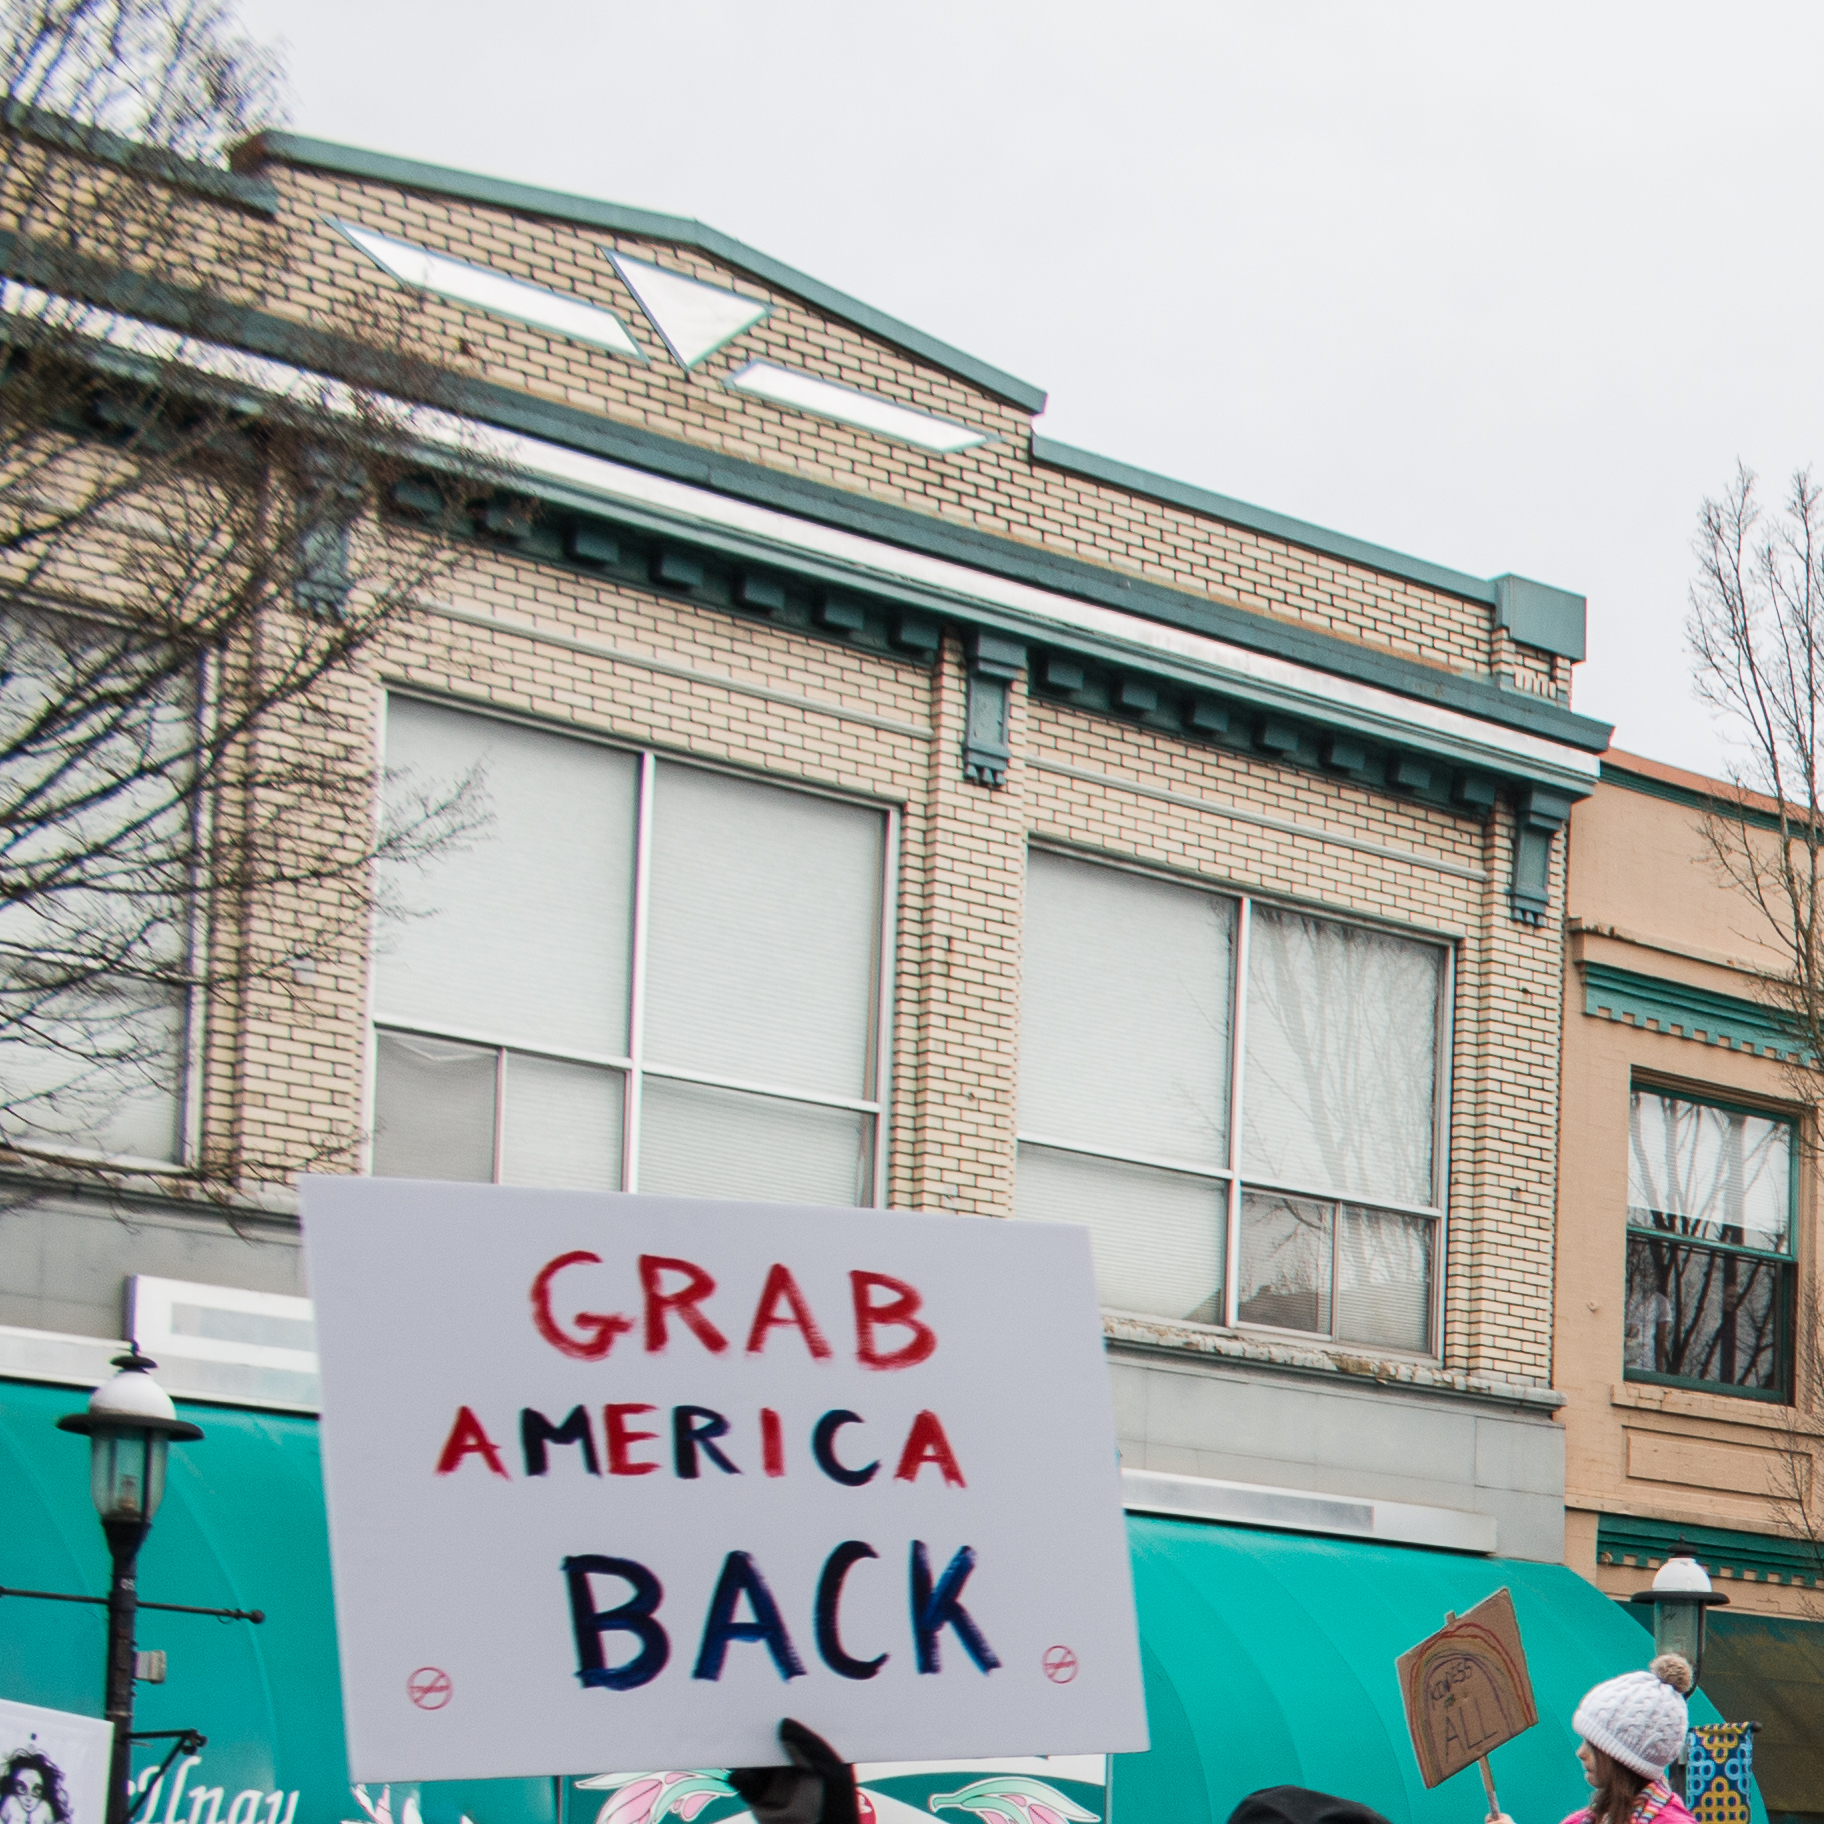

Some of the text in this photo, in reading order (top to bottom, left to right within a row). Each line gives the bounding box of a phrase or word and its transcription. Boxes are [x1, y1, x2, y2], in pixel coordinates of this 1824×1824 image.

[532, 1248, 938, 1372] GRAB
[436, 1403, 966, 1487] AMERICA
[562, 1539, 1003, 1692] BACK
[1444, 1697, 1498, 1764] ALL
